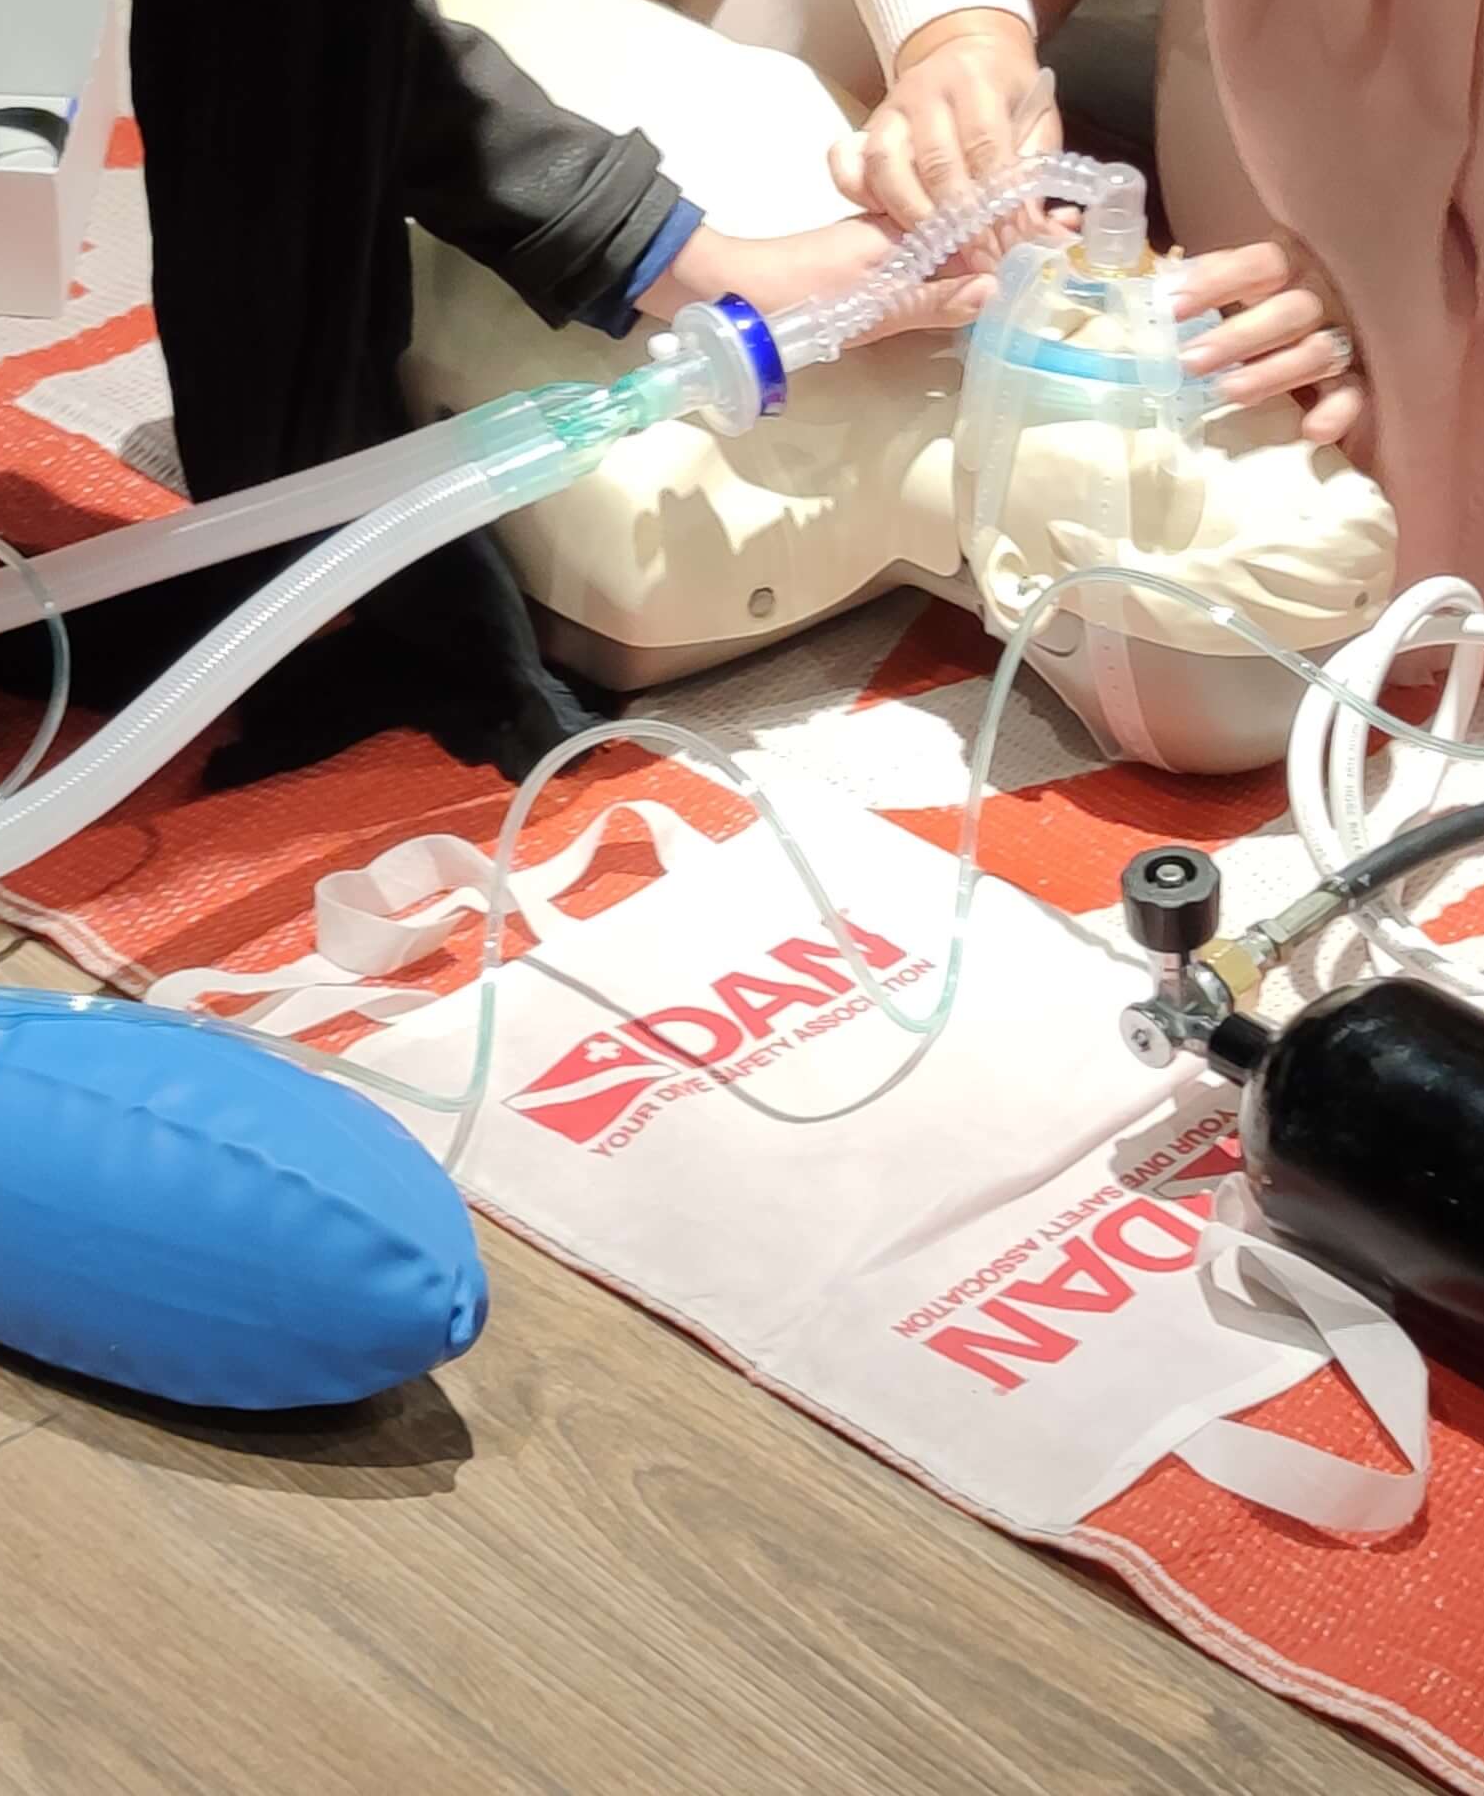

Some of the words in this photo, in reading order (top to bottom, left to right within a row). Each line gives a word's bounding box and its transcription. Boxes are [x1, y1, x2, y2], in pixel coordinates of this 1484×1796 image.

[615, 912, 908, 1068] DAN
[589, 1102, 661, 1158] YOUR
[654, 1077, 715, 1103] DIVE
[708, 1035, 796, 1085] SAFETY
[791, 958, 937, 1043] ASSOCITION
[1118, 1151, 1177, 1189] DIVE
[1168, 1107, 1239, 1157] YOUR
[1036, 1184, 1125, 1241] SAFETY
[890, 1236, 1041, 1339] ASSOCIATION
[920, 1196, 1203, 1391] DAN
